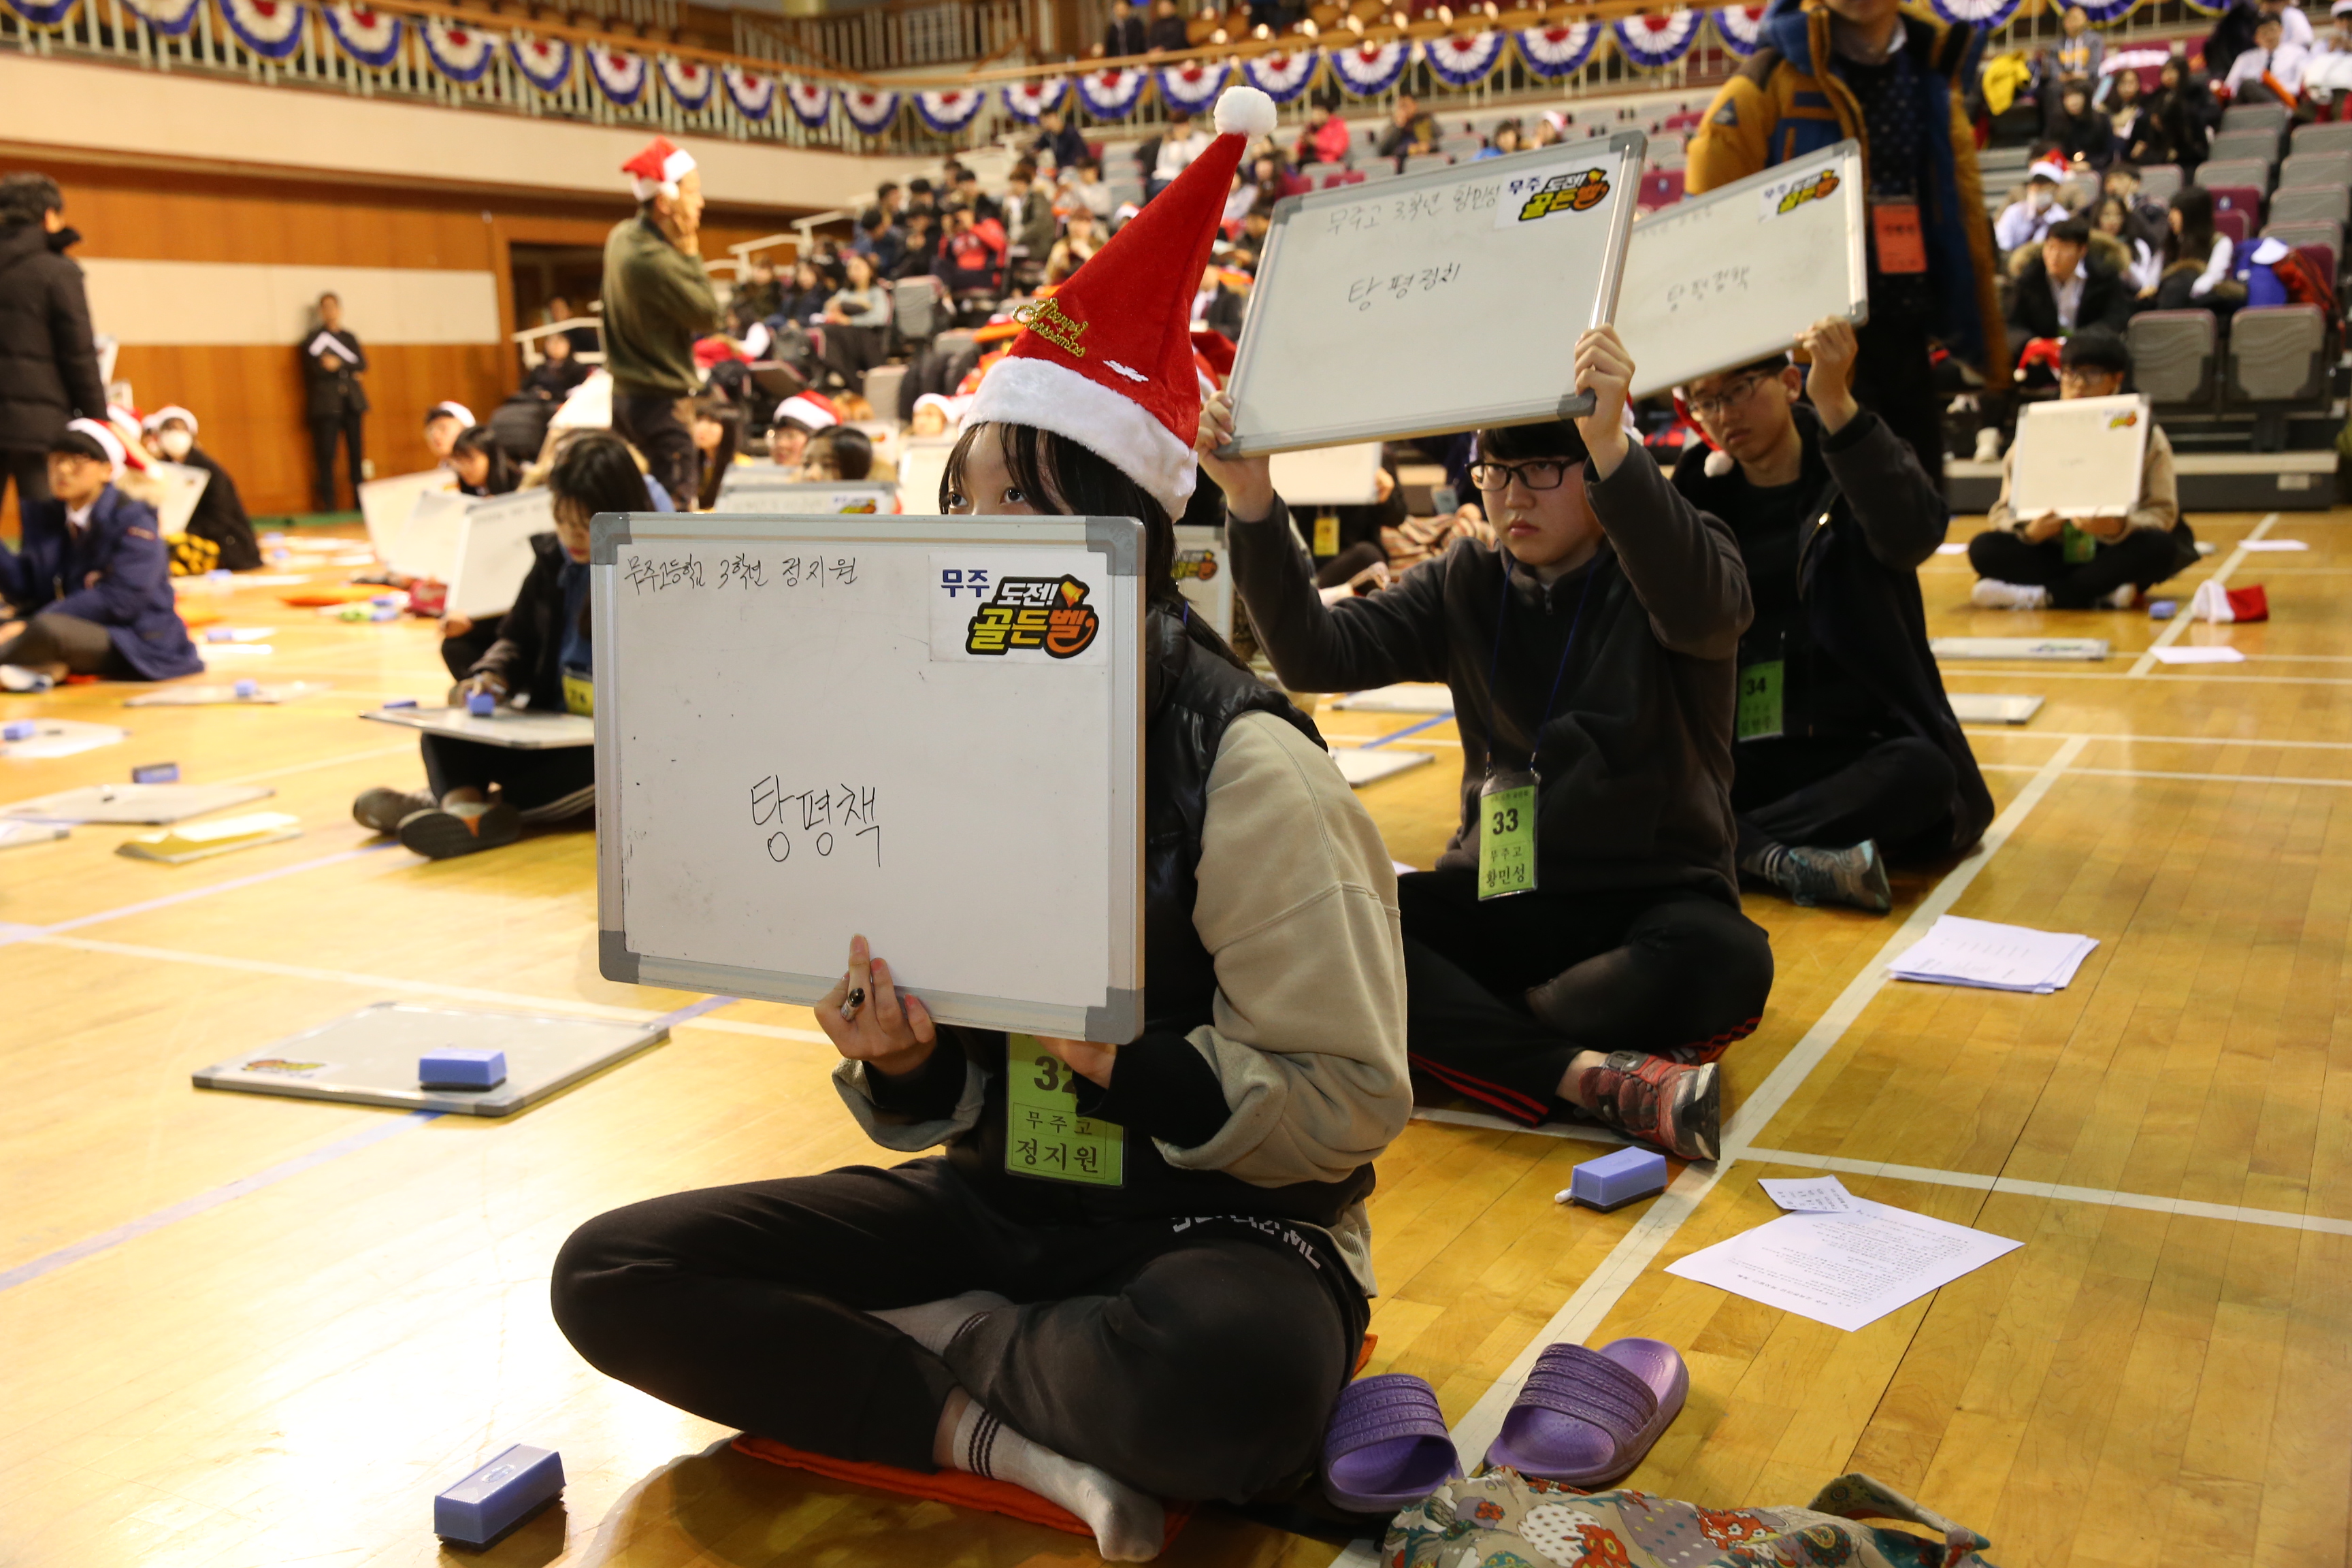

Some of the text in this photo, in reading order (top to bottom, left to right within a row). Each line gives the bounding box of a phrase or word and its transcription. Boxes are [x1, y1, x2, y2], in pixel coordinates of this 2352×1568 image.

[1327, 206, 1381, 235] 무주고
[717, 553, 769, 589] 3학년
[783, 555, 858, 587] 정지원
[941, 569, 1060, 606] 무주 도전!
[970, 608, 1095, 654] 골든벨
[1746, 676, 1767, 696] 34
[750, 774, 881, 868] 탕평책
[1492, 808, 1518, 835] 33
[1490, 846, 1522, 863] 무주고
[1486, 863, 1524, 887] 황민성
[1026, 1111, 1092, 1135] 무주고
[1015, 1138, 1098, 1173] 정지원
